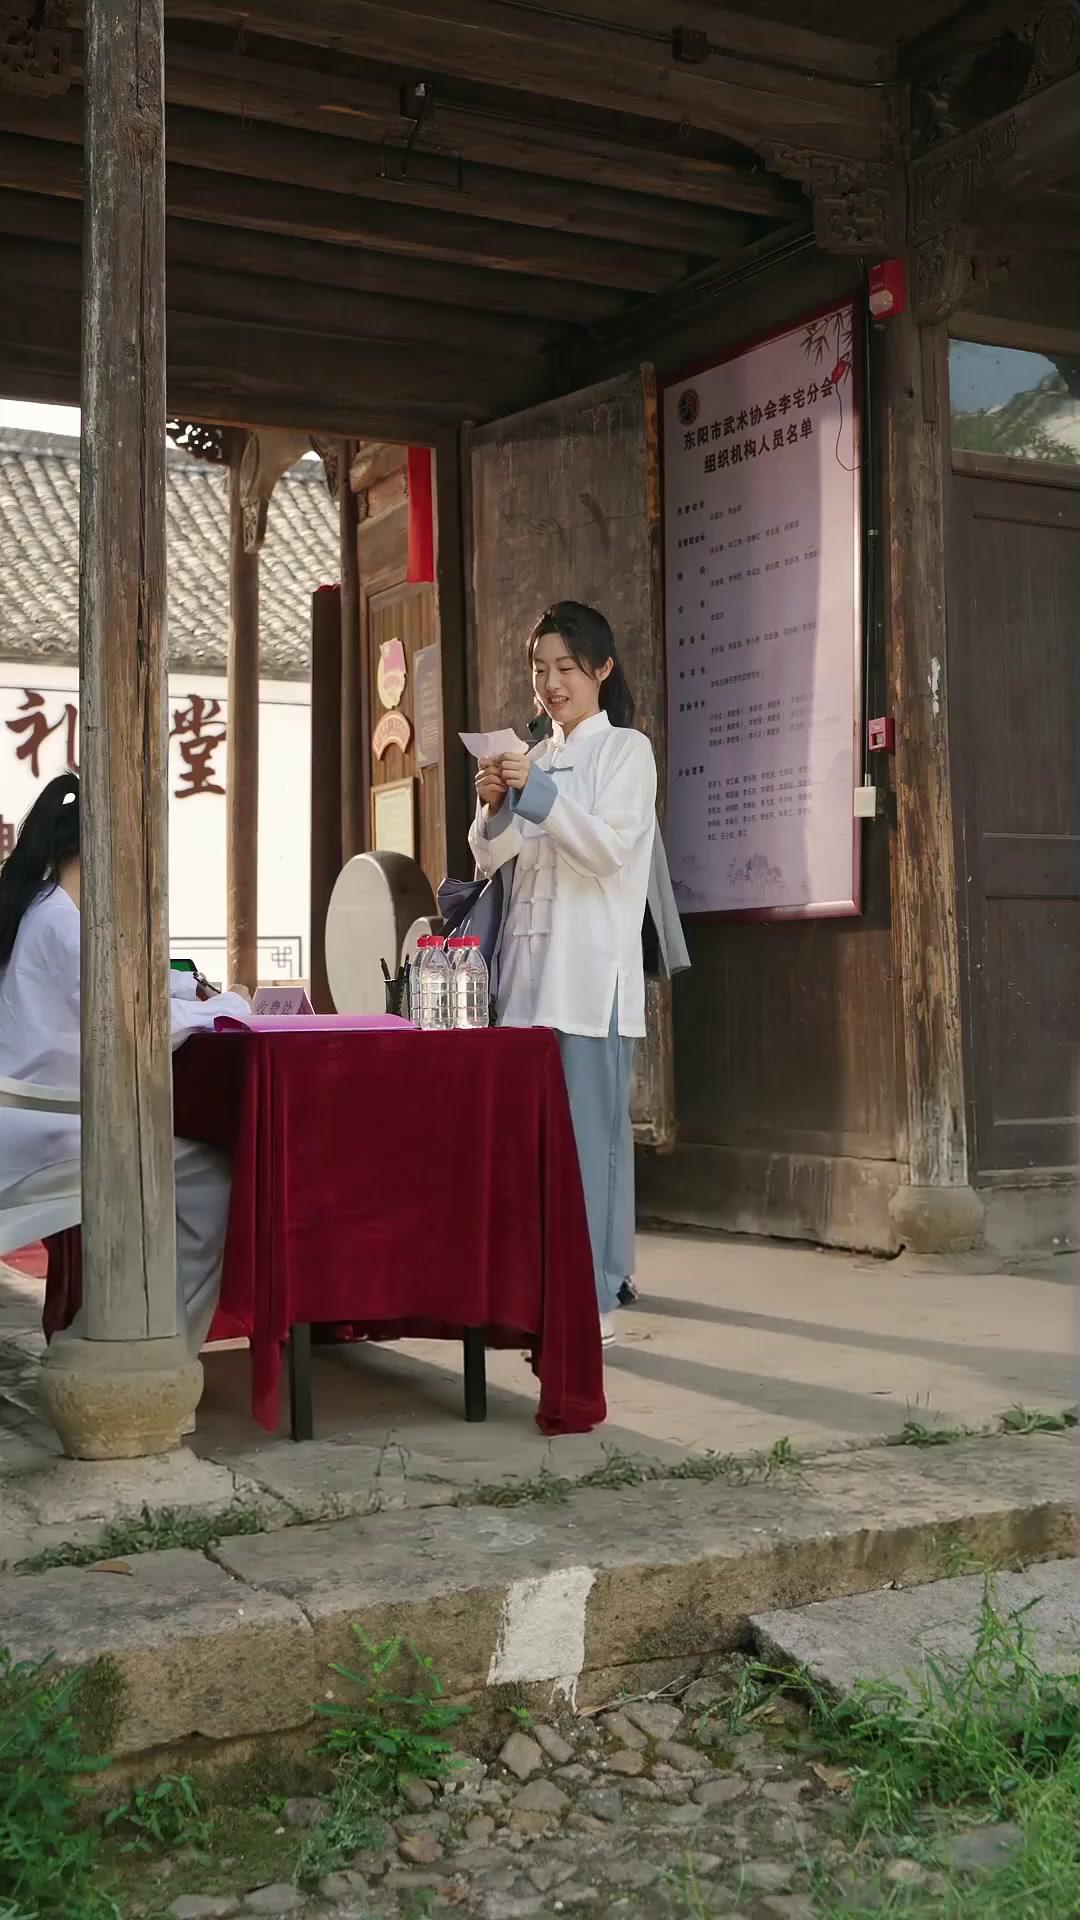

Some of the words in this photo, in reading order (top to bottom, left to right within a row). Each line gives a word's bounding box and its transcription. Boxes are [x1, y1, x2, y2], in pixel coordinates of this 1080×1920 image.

[683, 376, 833, 451] 东阳市武术协会李宅分会
[703, 417, 814, 474] 组织机构人员名单
